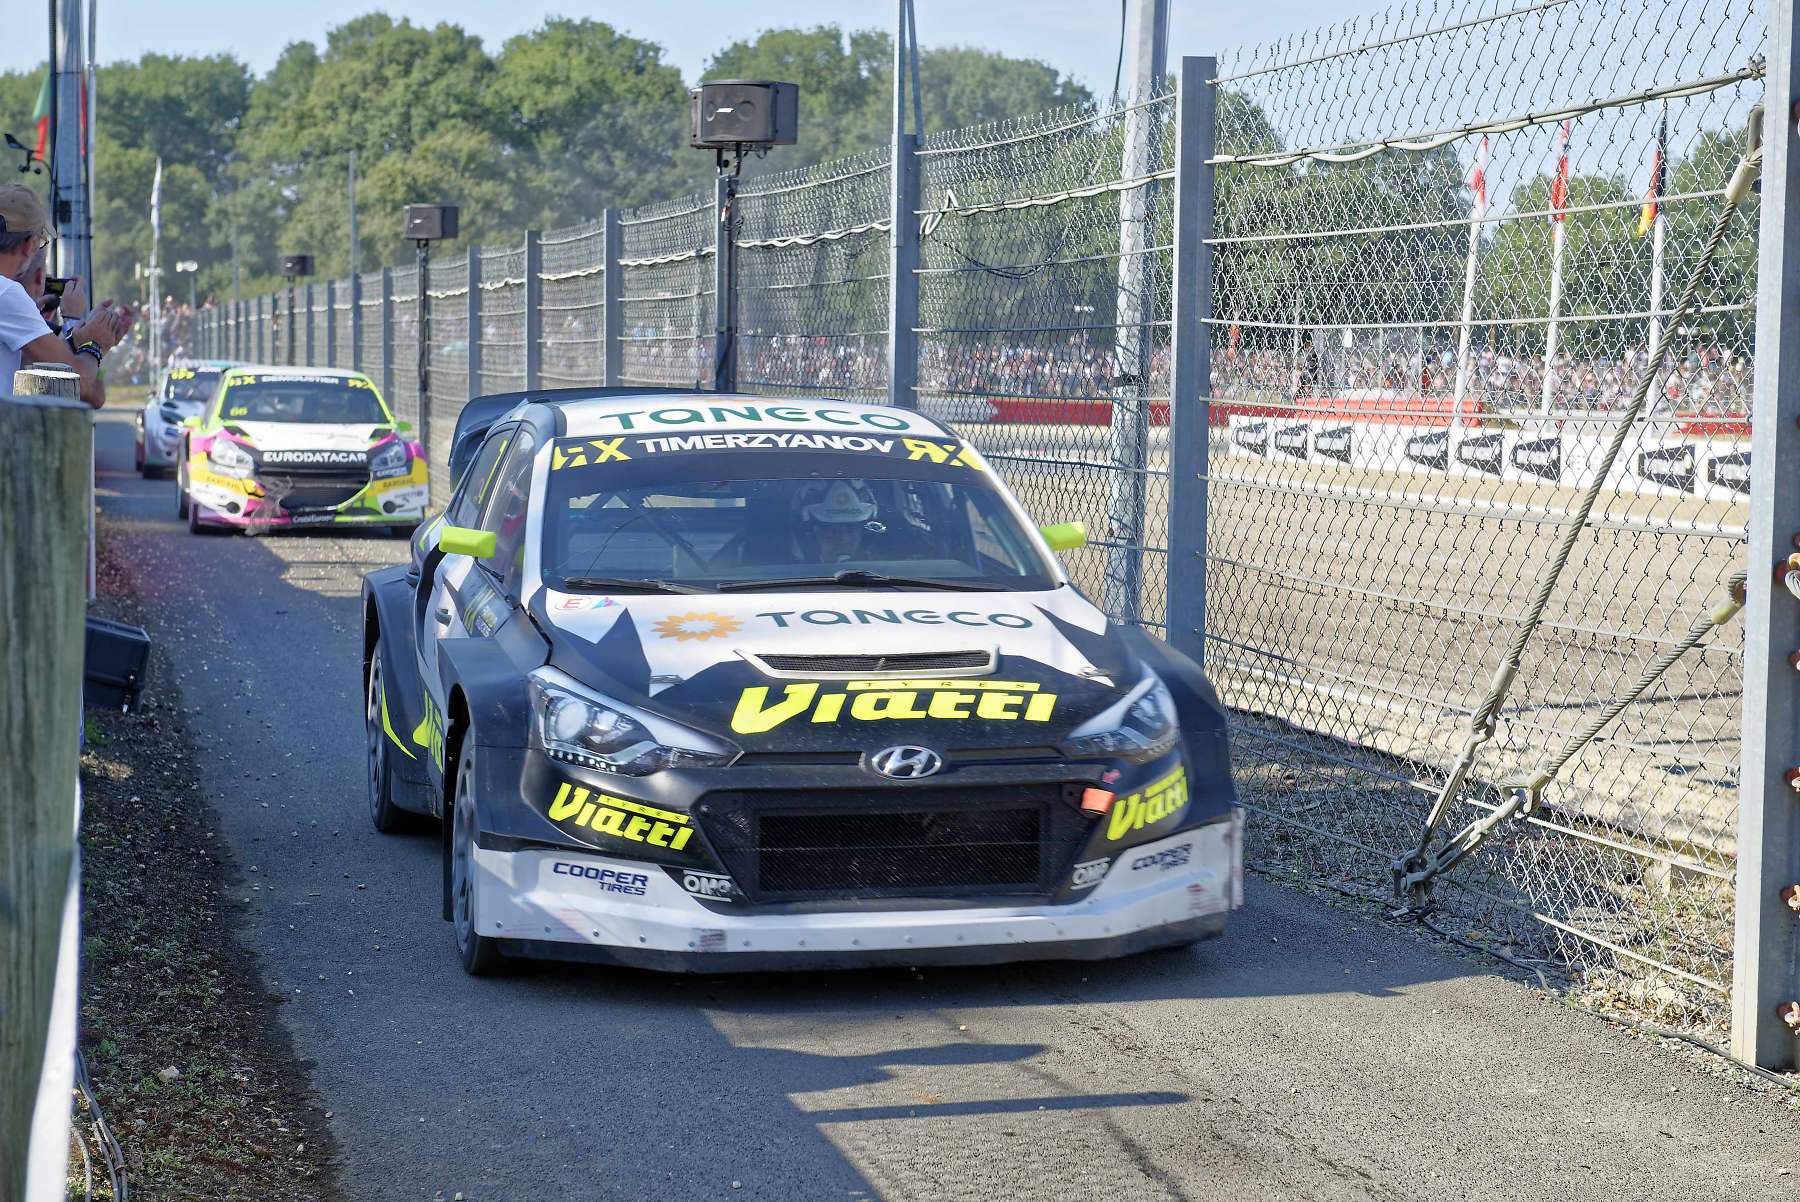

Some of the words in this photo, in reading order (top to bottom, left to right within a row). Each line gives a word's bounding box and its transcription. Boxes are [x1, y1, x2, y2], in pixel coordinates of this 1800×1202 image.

[599, 406, 912, 431] TANECO
[636, 433, 895, 453] TIMERZYANOV
[262, 451, 368, 464] EURODATACAR
[755, 608, 1034, 630] TANECO
[730, 682, 1058, 735] Viatti
[548, 782, 695, 851] Viatti
[1106, 775, 1189, 841] Viatti
[553, 862, 649, 887] COOPER
[598, 880, 647, 897] TIRES
